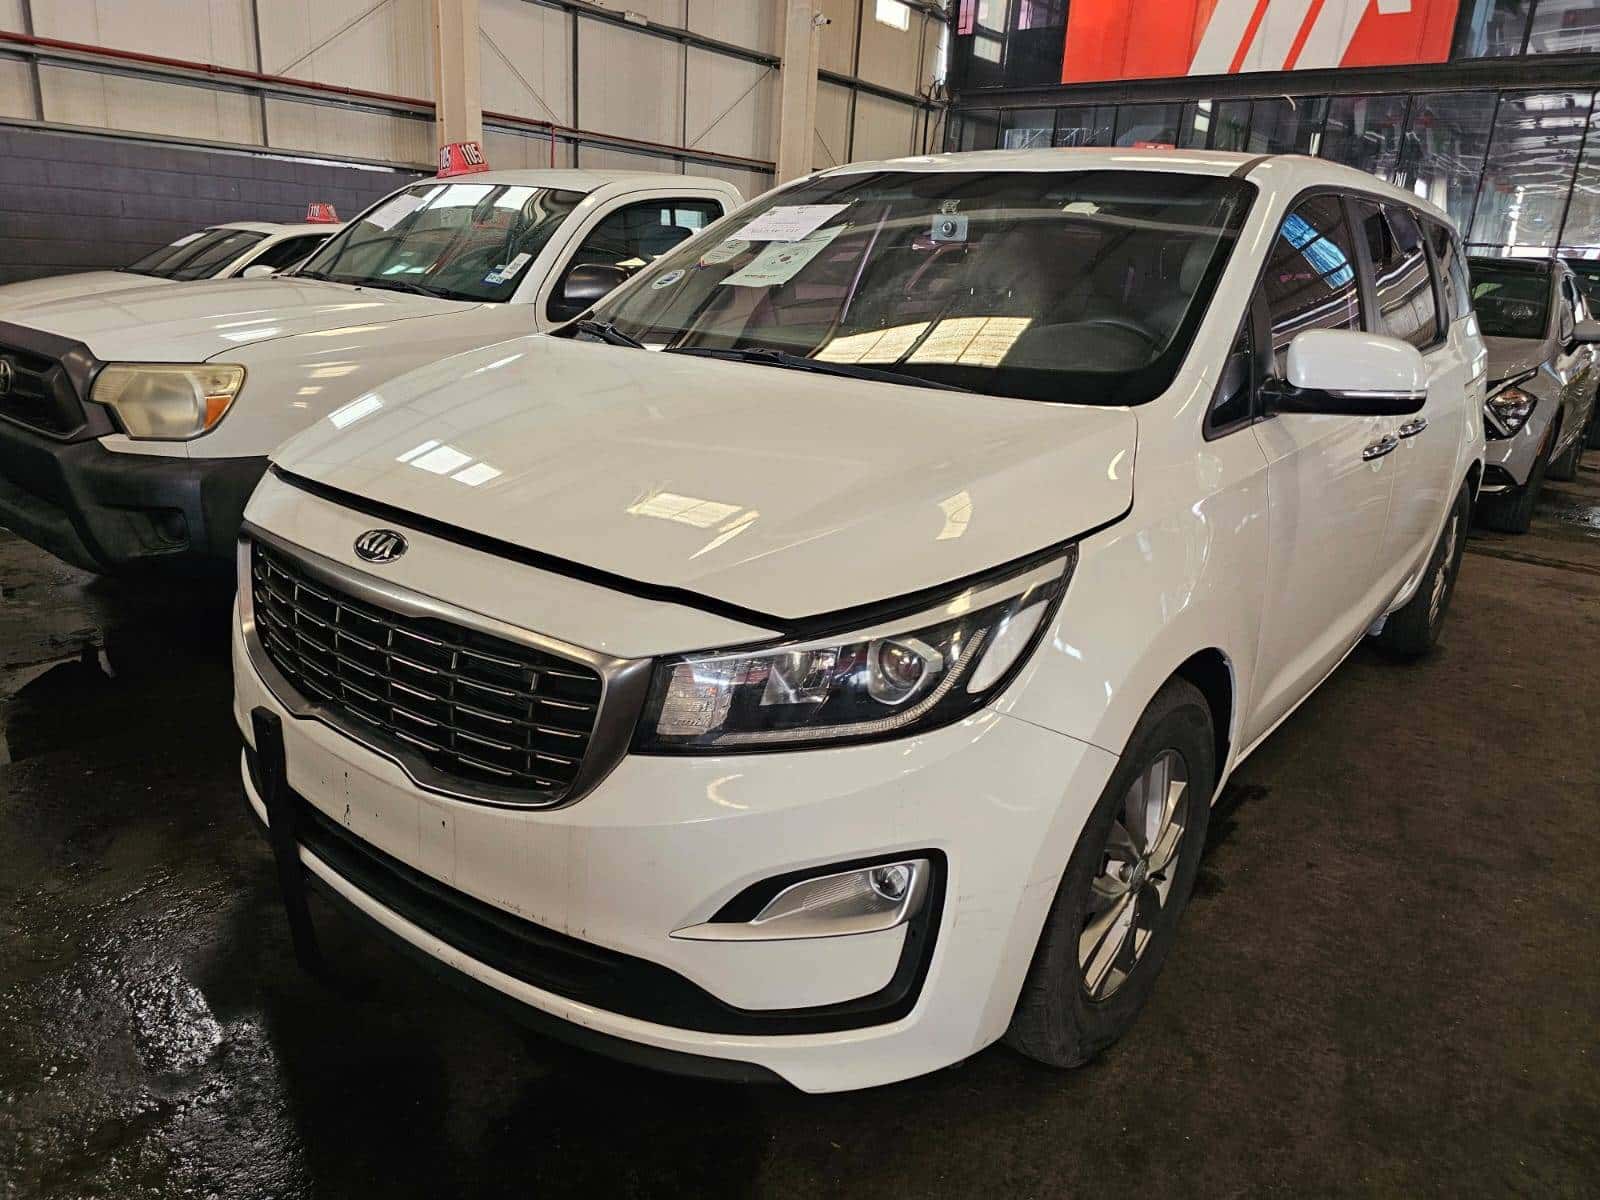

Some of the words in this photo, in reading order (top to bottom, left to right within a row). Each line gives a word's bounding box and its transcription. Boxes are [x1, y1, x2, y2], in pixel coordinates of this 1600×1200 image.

[440, 144, 451, 170] 105
[460, 143, 485, 165] 105
[357, 531, 399, 558] KIA
